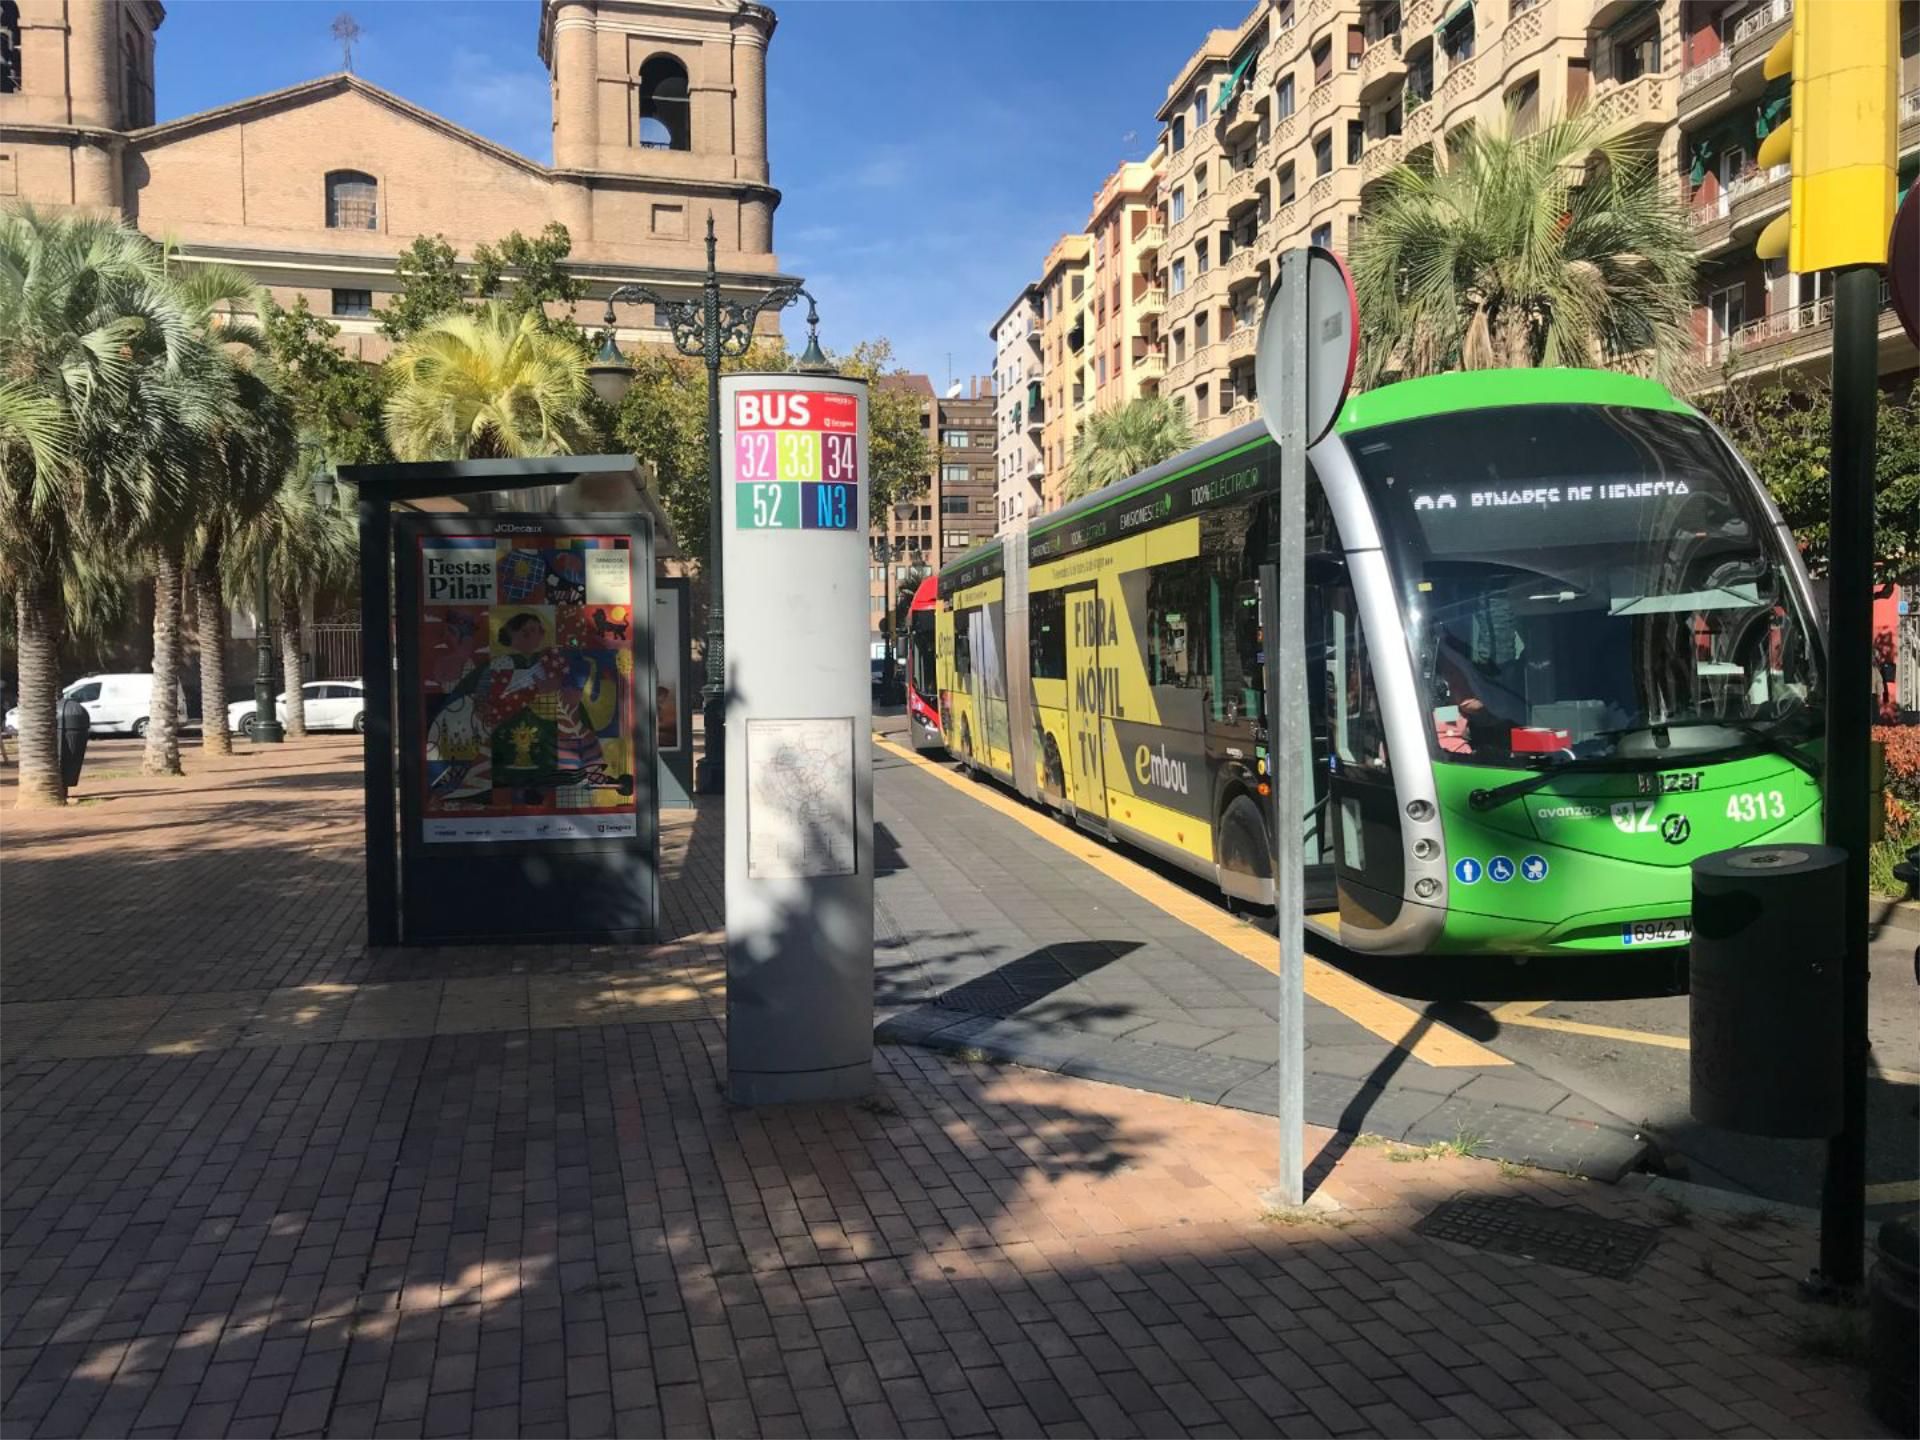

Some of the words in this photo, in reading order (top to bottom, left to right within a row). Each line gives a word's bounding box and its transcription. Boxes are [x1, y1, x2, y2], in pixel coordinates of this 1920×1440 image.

[738, 394, 811, 427] BUS
[741, 434, 770, 478] 32
[784, 434, 814, 478] 33
[827, 435, 854, 479] 34
[753, 484, 783, 527] 52
[817, 484, 847, 528] N3
[428, 558, 491, 575] Fiestas
[429, 576, 492, 600] Pilar
[1074, 598, 1119, 648] FIBRA
[1075, 656, 1125, 719] MÓVIL
[1078, 730, 1098, 779] TV
[1135, 743, 1189, 795] embou
[1538, 805, 1592, 819] avanza
[1725, 790, 1786, 823] 4313
[1634, 921, 1677, 942] 6942
